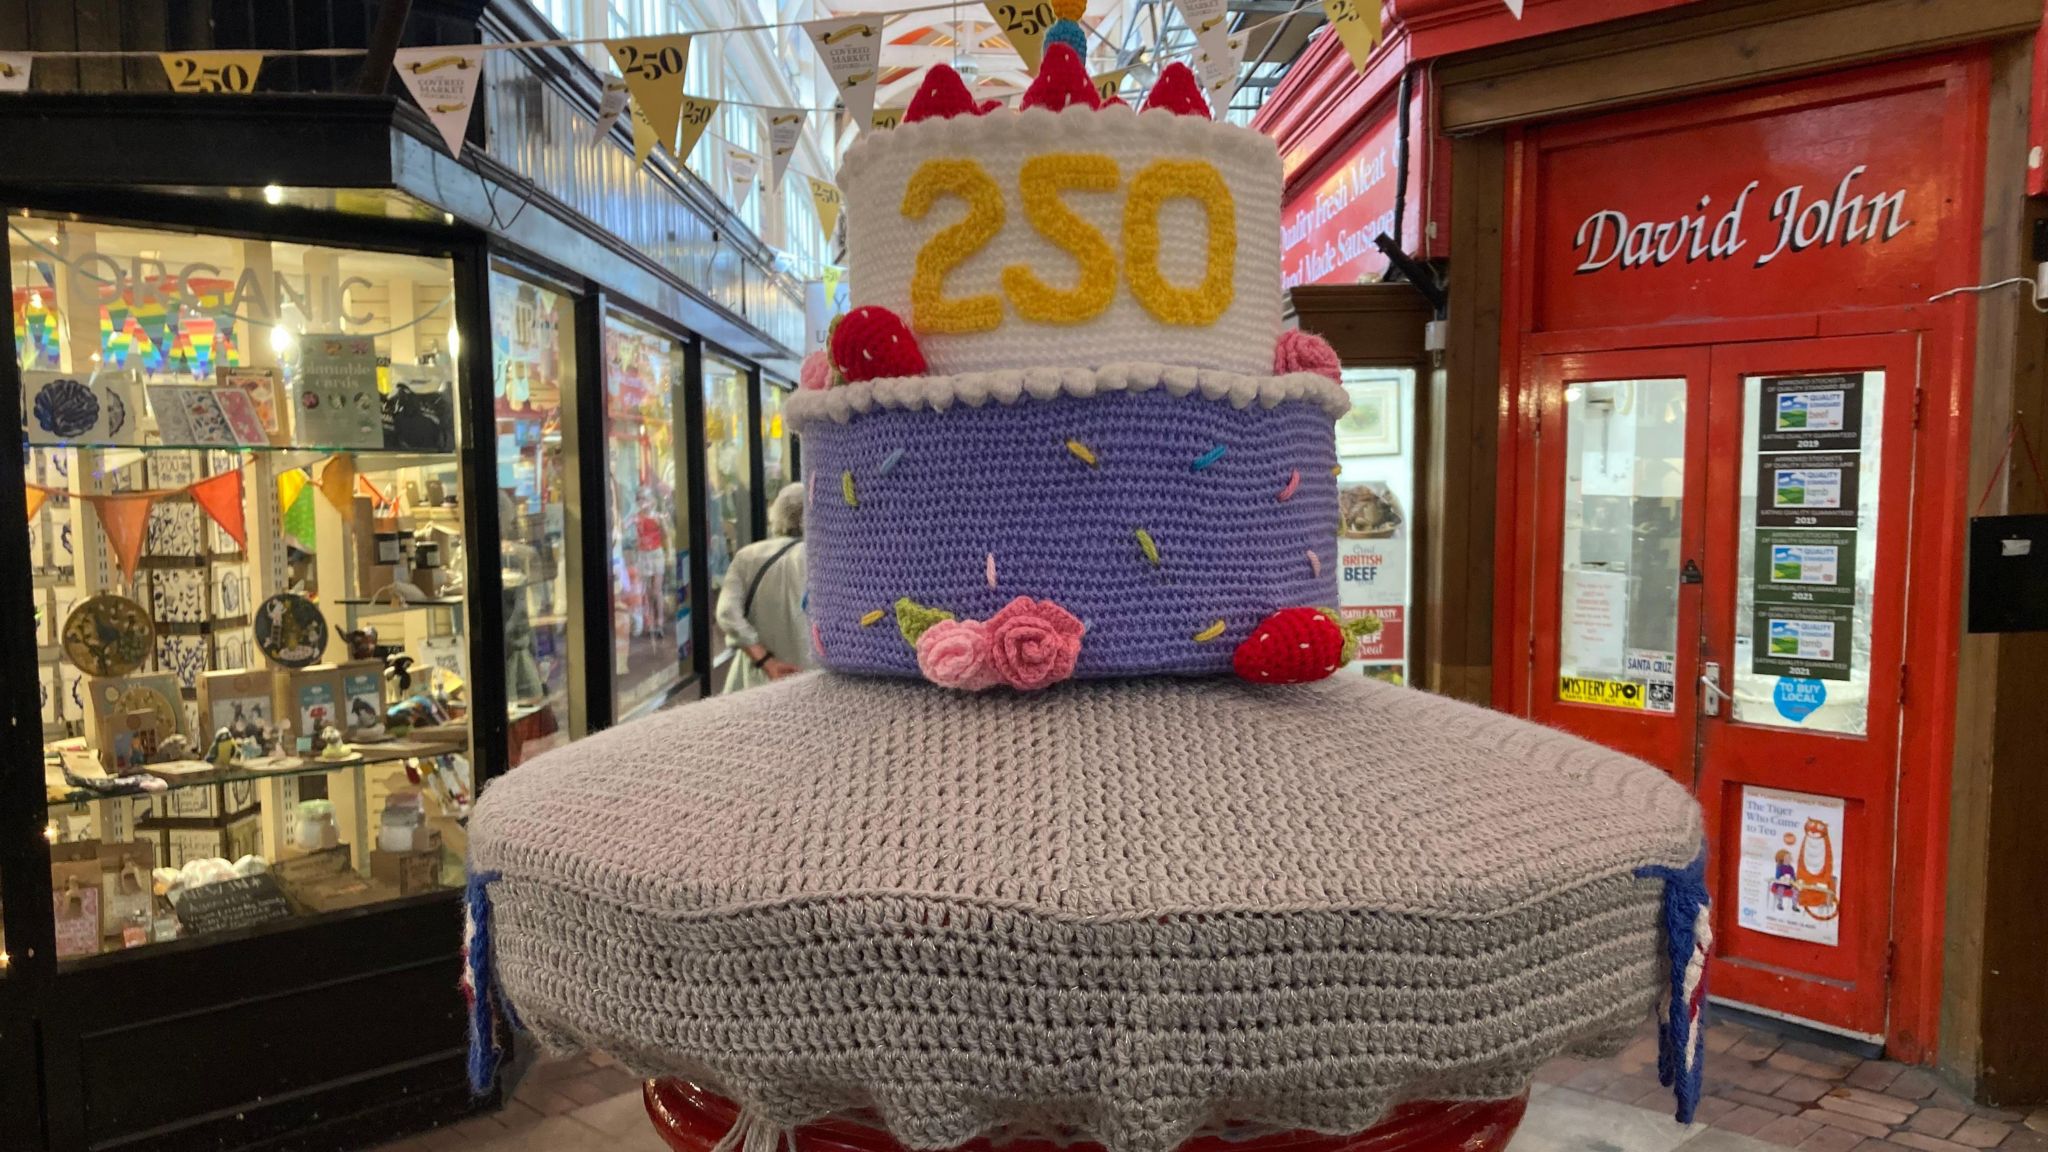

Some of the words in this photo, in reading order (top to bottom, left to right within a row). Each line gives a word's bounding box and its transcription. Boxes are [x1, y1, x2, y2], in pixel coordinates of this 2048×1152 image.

[998, 2, 1055, 36] 250
[617, 45, 683, 80] 250
[831, 54, 872, 64] MARKET
[174, 58, 249, 92] 250
[419, 86, 464, 95] MARKET
[684, 101, 711, 125] 250
[811, 181, 841, 206] 250
[1315, 175, 1348, 230] Fresh
[1350, 147, 1387, 202] Meat
[1574, 180, 1759, 274] David
[1754, 165, 1911, 268] John
[901, 152, 1237, 334] 250
[1304, 240, 1337, 285] Made
[68, 251, 375, 326] ORGANIC
[1809, 393, 1841, 401] QUALITY
[1809, 410, 1829, 419] beef
[1797, 440, 1820, 448] 2019
[1807, 488, 1829, 497] lamb
[1794, 517, 1818, 525] 2019
[1343, 555, 1383, 566] BRITISH
[1344, 567, 1378, 581] BEEF
[1803, 564, 1823, 572] beef
[1792, 592, 1814, 601] 2021
[1376, 608, 1397, 618] TASTY
[1801, 640, 1823, 648] lamb
[1627, 658, 1651, 671] SANTA
[1653, 660, 1673, 674] CRUZ
[1789, 666, 1811, 675] 2021
[1561, 677, 1606, 697] MYSTERY
[1608, 681, 1641, 700] SPOT
[1780, 682, 1794, 692] TO
[1797, 683, 1821, 694] BUY
[1782, 692, 1818, 704] LOCAL
[1747, 801, 1764, 811] The
[1766, 803, 1793, 816] Tiger
[1746, 812, 1769, 823] Who
[1770, 816, 1800, 828] Came
[1746, 824, 1756, 833] to
[1758, 825, 1777, 836] Tea
